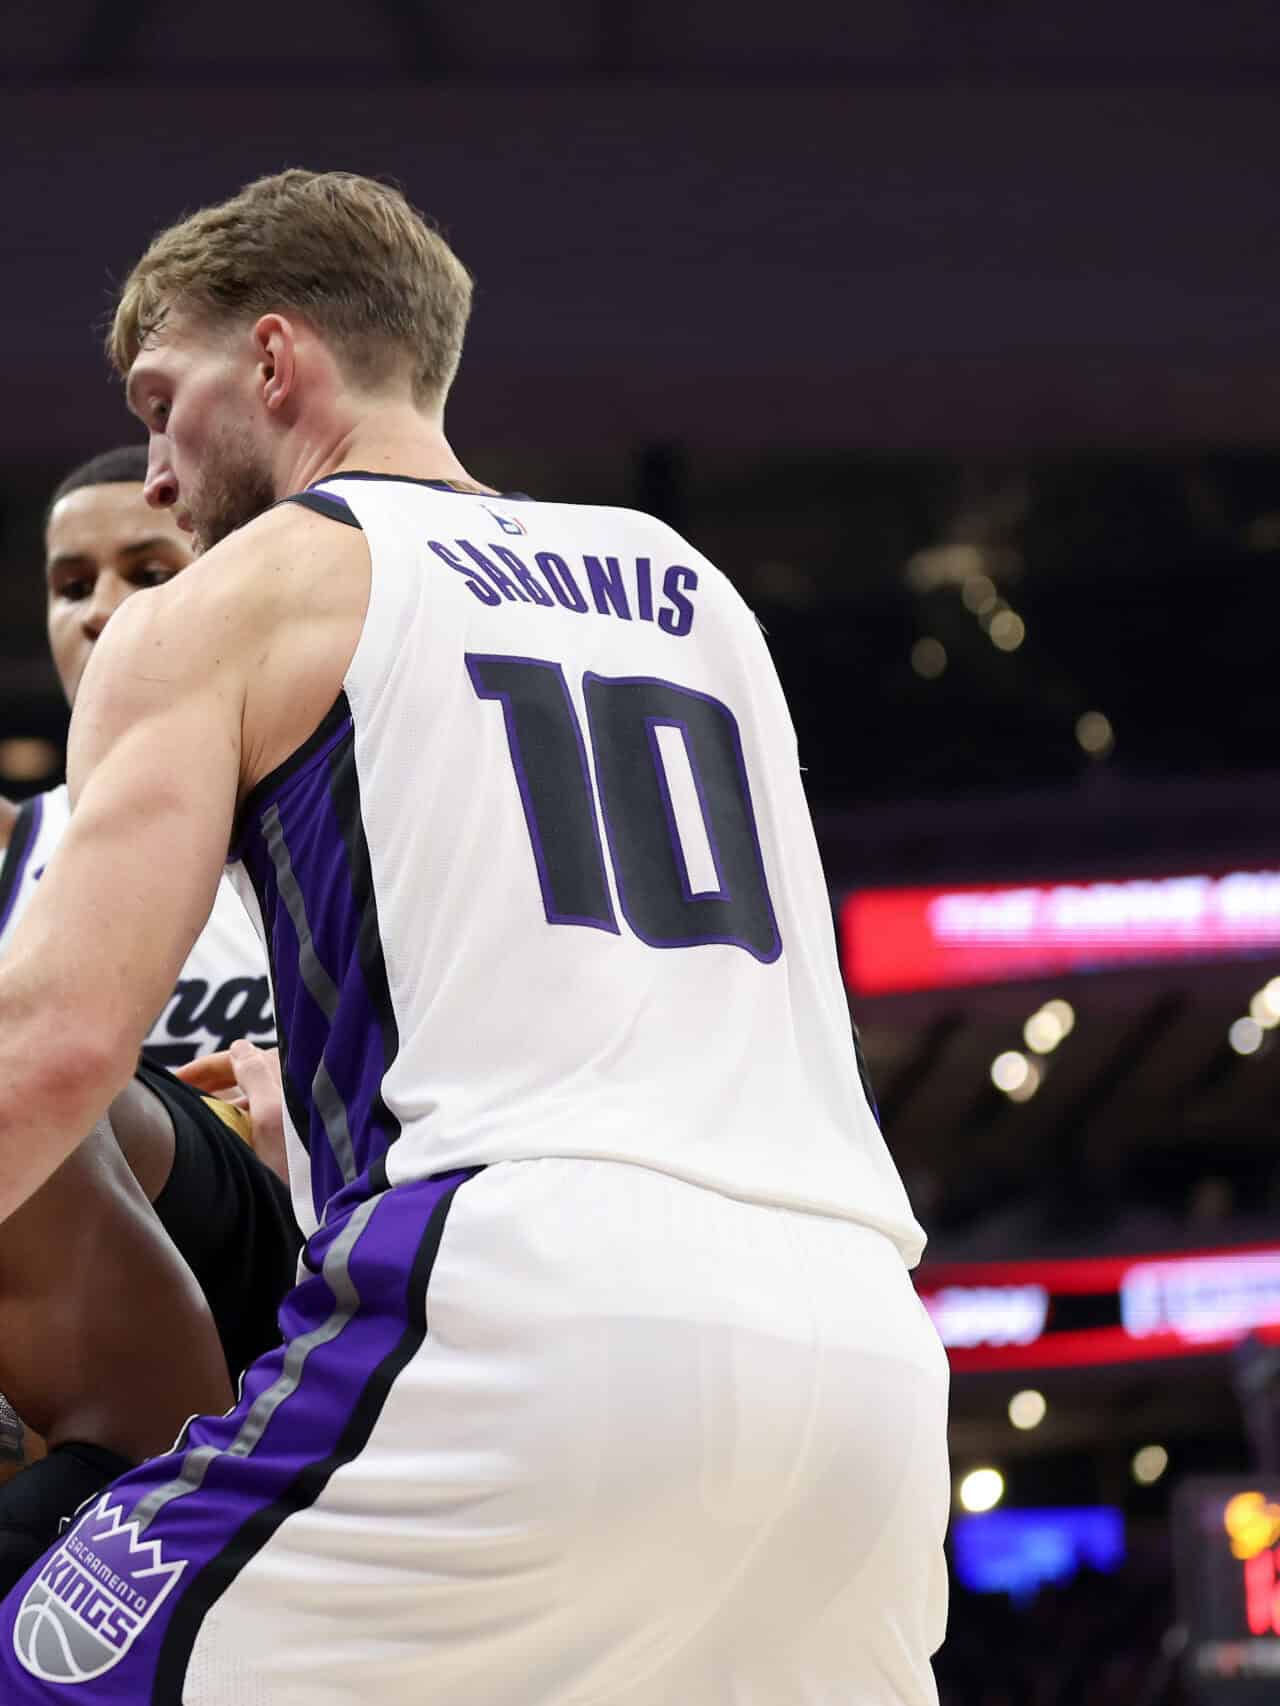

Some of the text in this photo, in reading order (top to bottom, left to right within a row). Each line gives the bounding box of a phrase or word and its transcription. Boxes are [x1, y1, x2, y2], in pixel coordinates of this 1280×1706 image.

[427, 538, 698, 637] SABONIS
[464, 652, 783, 965] 10
[41, 1551, 138, 1650] KINGS
[67, 1536, 148, 1612] SACRAMENTO
